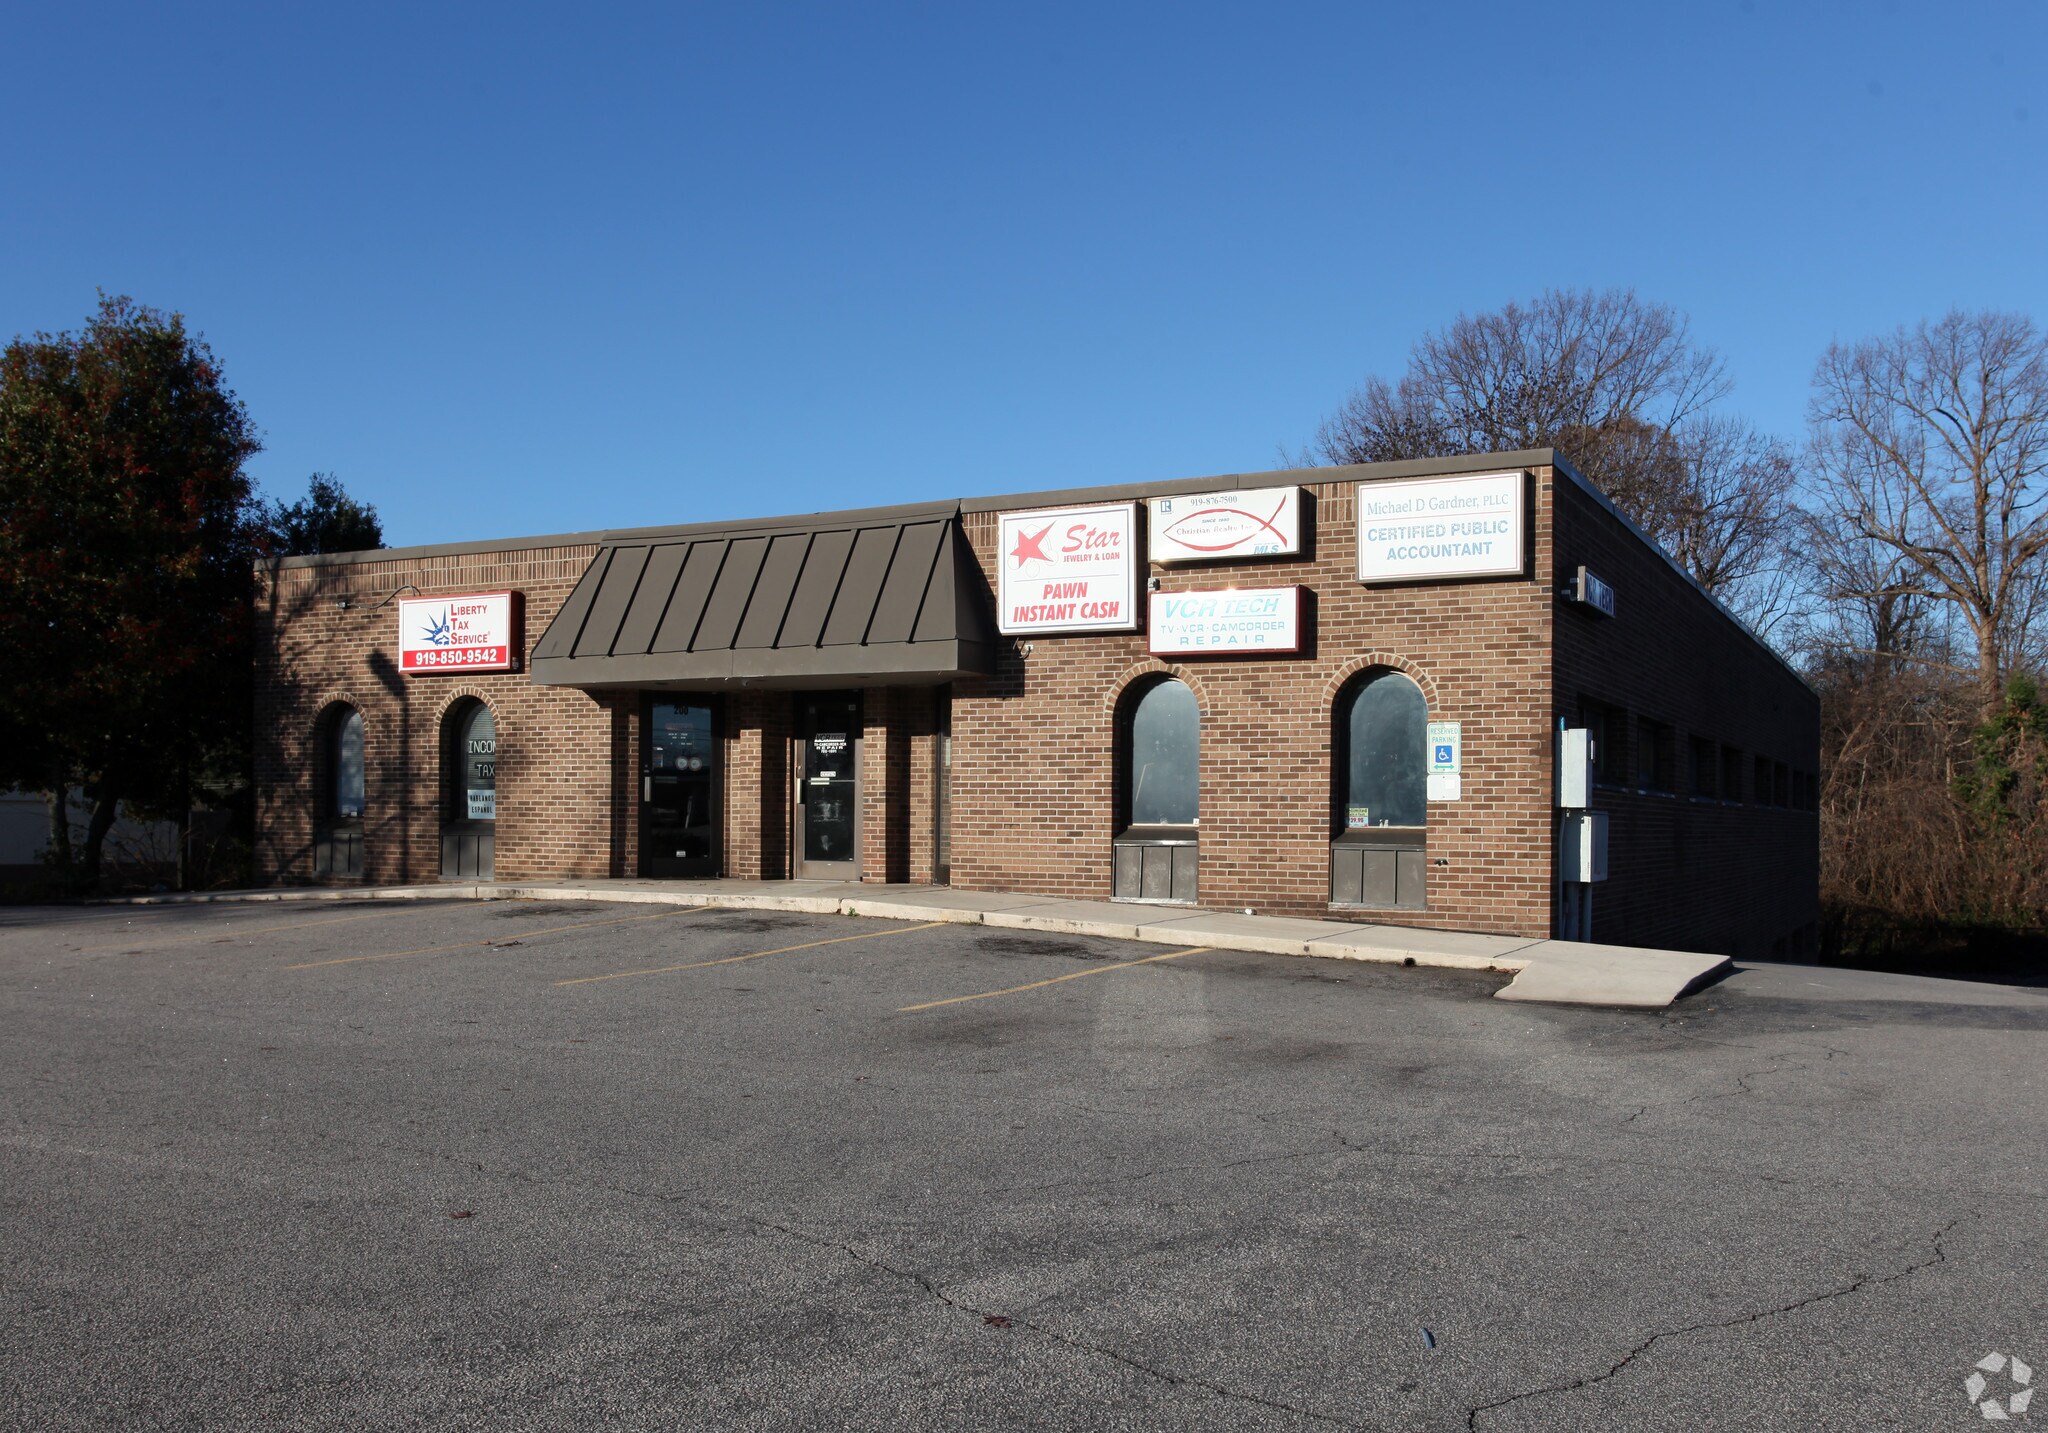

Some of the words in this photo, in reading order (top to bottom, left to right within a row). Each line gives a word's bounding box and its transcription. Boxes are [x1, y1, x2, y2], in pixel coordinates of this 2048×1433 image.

[1190, 495, 1238, 506] 919-876-7500
[1367, 499, 1412, 516] Michael
[1415, 498, 1425, 512] D
[1429, 495, 1480, 511] Gardner,
[1483, 493, 1509, 506] PLLC
[1176, 525, 1211, 536] Christian
[1367, 523, 1446, 542] CERTIFIED
[1451, 520, 1509, 537] PUBLIC
[1061, 524, 1121, 553] Star
[1254, 544, 1279, 555] MLS
[1387, 541, 1493, 561] ACCOUNTANT
[1063, 553, 1092, 563] JEWELRY
[1094, 553, 1100, 561] &
[1102, 551, 1120, 561] LOAN
[1043, 582, 1088, 600] PAWN
[450, 603, 488, 616] LIBERTY
[1013, 603, 1076, 623] INSTANT
[1080, 601, 1120, 619] CASH
[1165, 599, 1218, 619] VCR
[1225, 597, 1279, 614] TECH
[450, 618, 469, 630] TAX
[1161, 624, 1175, 635] TV
[1181, 623, 1204, 633] VCR
[1212, 621, 1285, 632] CAMCORDER
[450, 632, 488, 645] SERVICE
[1180, 634, 1265, 646] REPAIR
[415, 648, 498, 666] 919-850-9542
[1431, 727, 1459, 735] RESERVED
[477, 764, 496, 777] TAX
[471, 803, 493, 814] ESPAÑOL
